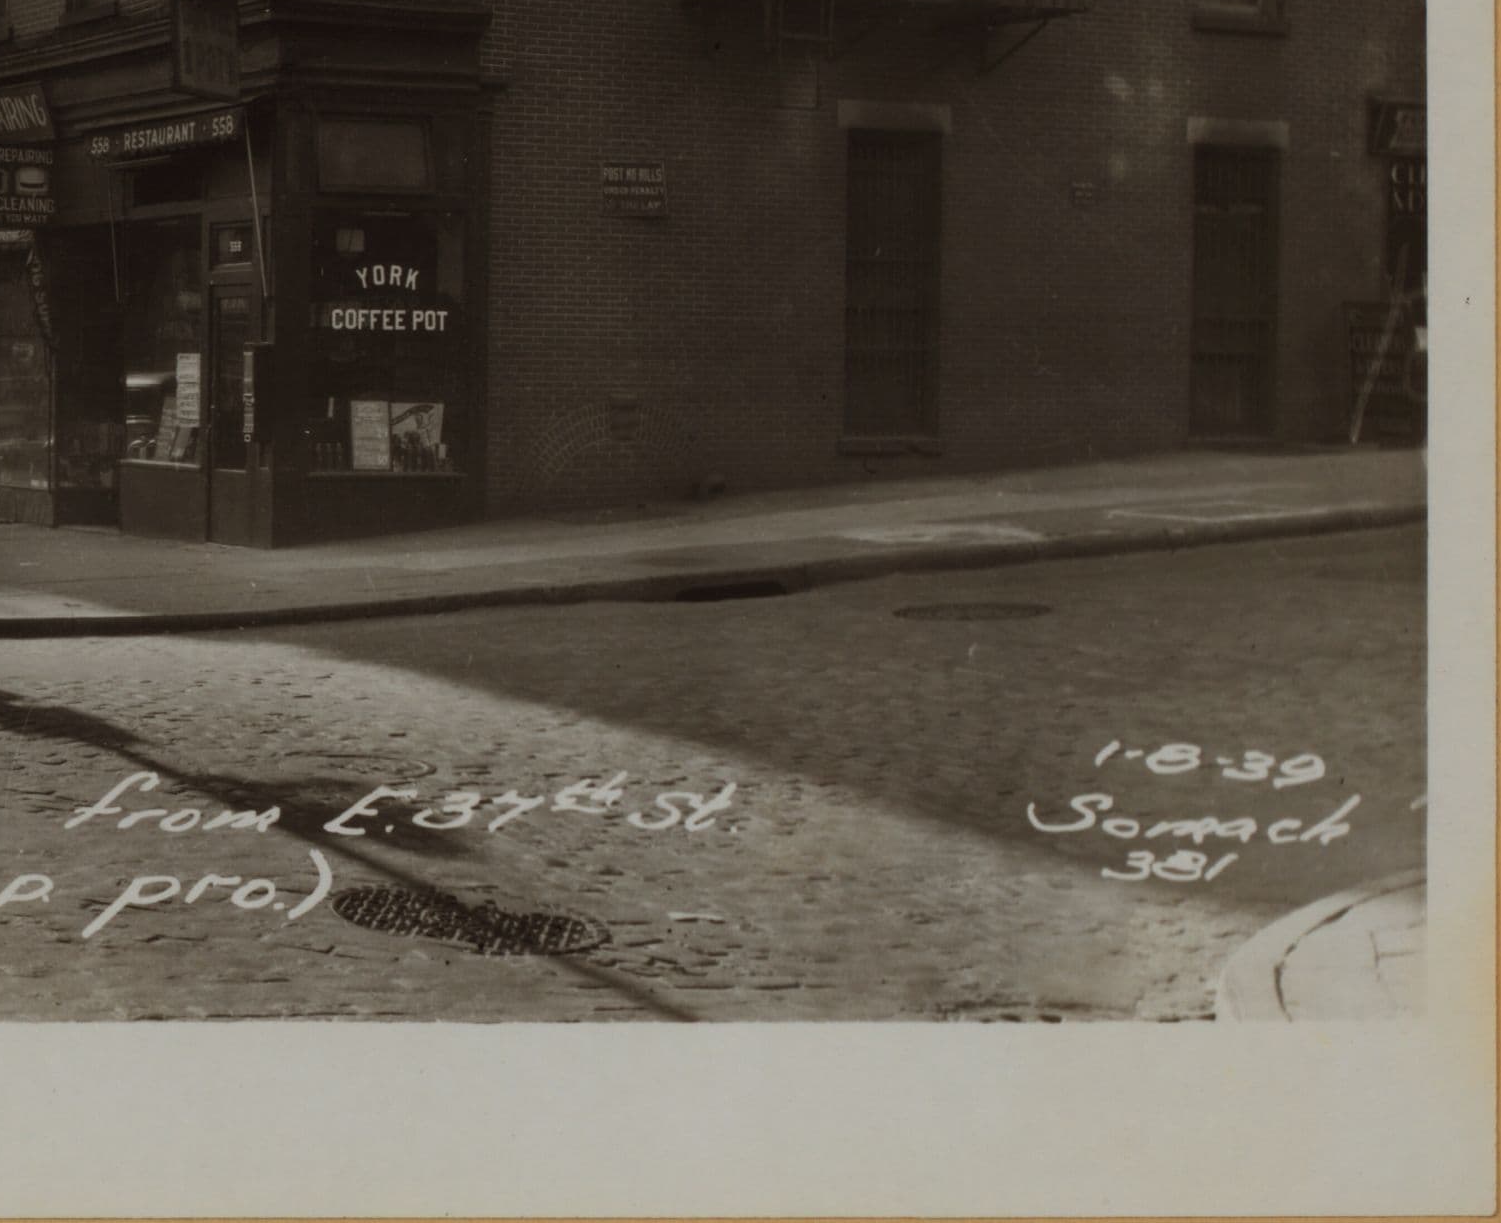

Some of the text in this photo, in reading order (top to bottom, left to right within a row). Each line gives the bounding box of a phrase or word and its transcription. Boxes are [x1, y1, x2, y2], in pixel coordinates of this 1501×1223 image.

[90, 114, 234, 155] 558 RESTAURANT 558
[603, 167, 623, 181] POST
[23, 214, 49, 225] WAIT
[356, 264, 419, 291] YORK
[331, 308, 448, 332] COFFEE POT
